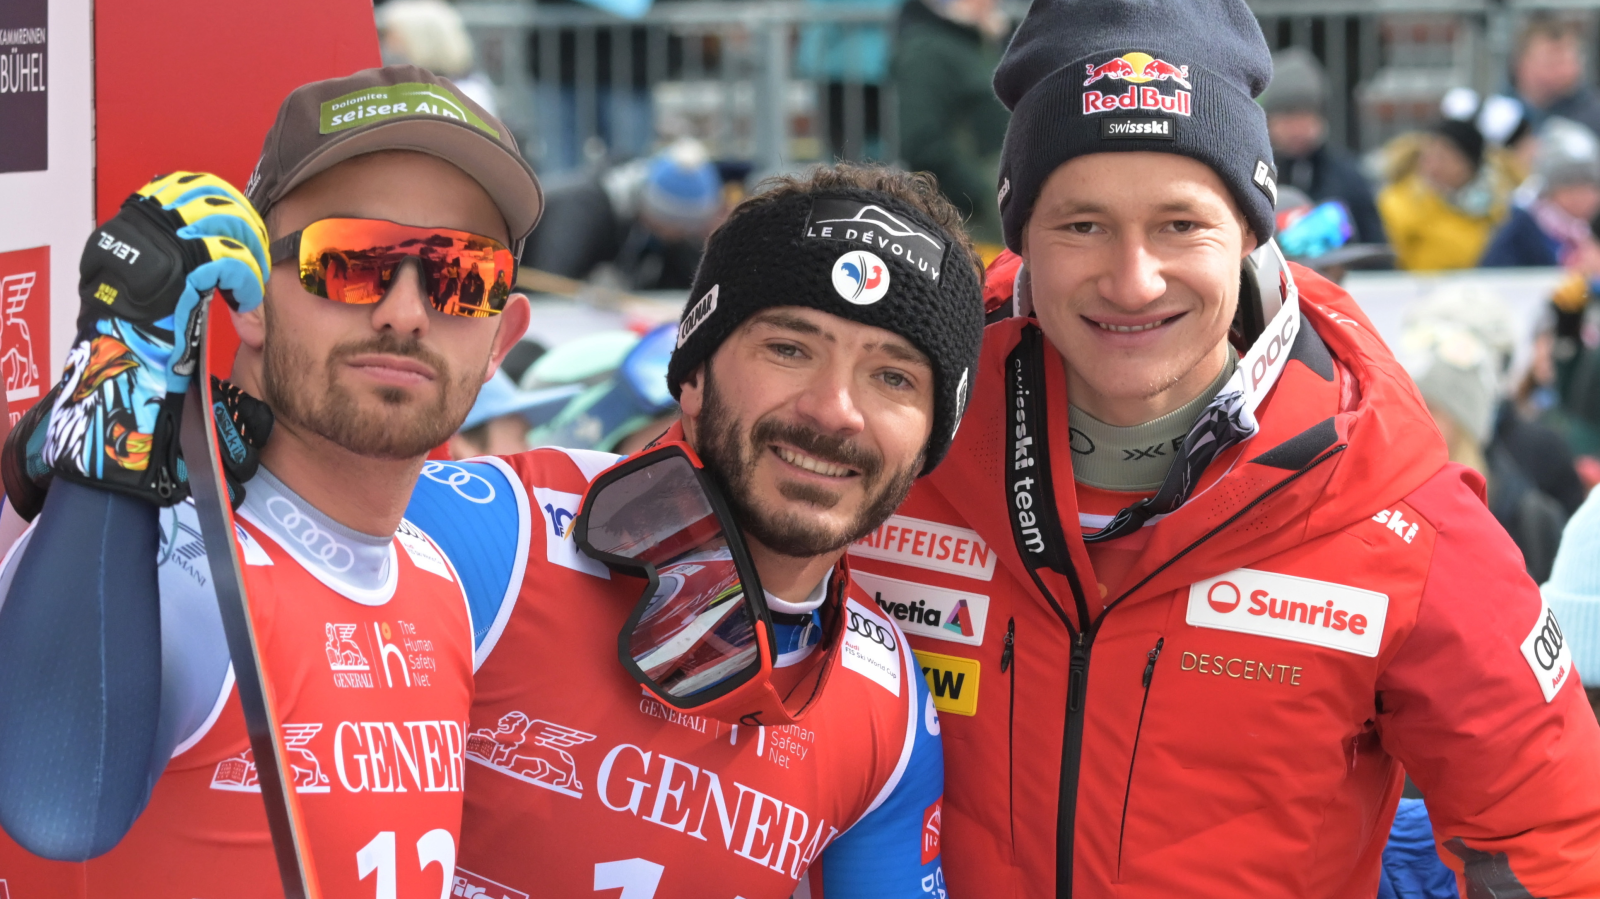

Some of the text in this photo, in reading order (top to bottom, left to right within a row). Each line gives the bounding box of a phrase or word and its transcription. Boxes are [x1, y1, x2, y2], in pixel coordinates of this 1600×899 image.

[0, 47, 46, 93] BÜHEL
[332, 93, 388, 111] Dolomites
[1083, 85, 1190, 116] Red Bull
[1108, 120, 1169, 134] swissski
[97, 231, 141, 265] LEVEL
[807, 227, 940, 280] LE DÉVOLUY
[681, 293, 713, 339] COLMAR
[1014, 477, 1046, 554] team
[1371, 509, 1419, 544] ski
[850, 525, 990, 569] AIFFEISEN
[398, 620, 417, 635] The
[1247, 589, 1368, 635] Sunrise
[403, 638, 434, 652] Human
[845, 640, 860, 651] Audi
[408, 654, 436, 672] Safety
[845, 646, 897, 679] FIS Ski World Cup
[1181, 651, 1303, 685] DESCENTE
[1551, 665, 1565, 689] Audi
[333, 673, 374, 688] GENERALI
[412, 672, 431, 687] Net
[922, 667, 965, 700] W
[639, 698, 708, 734] GENERALI
[769, 747, 790, 769] Net
[771, 731, 809, 761] Safety
